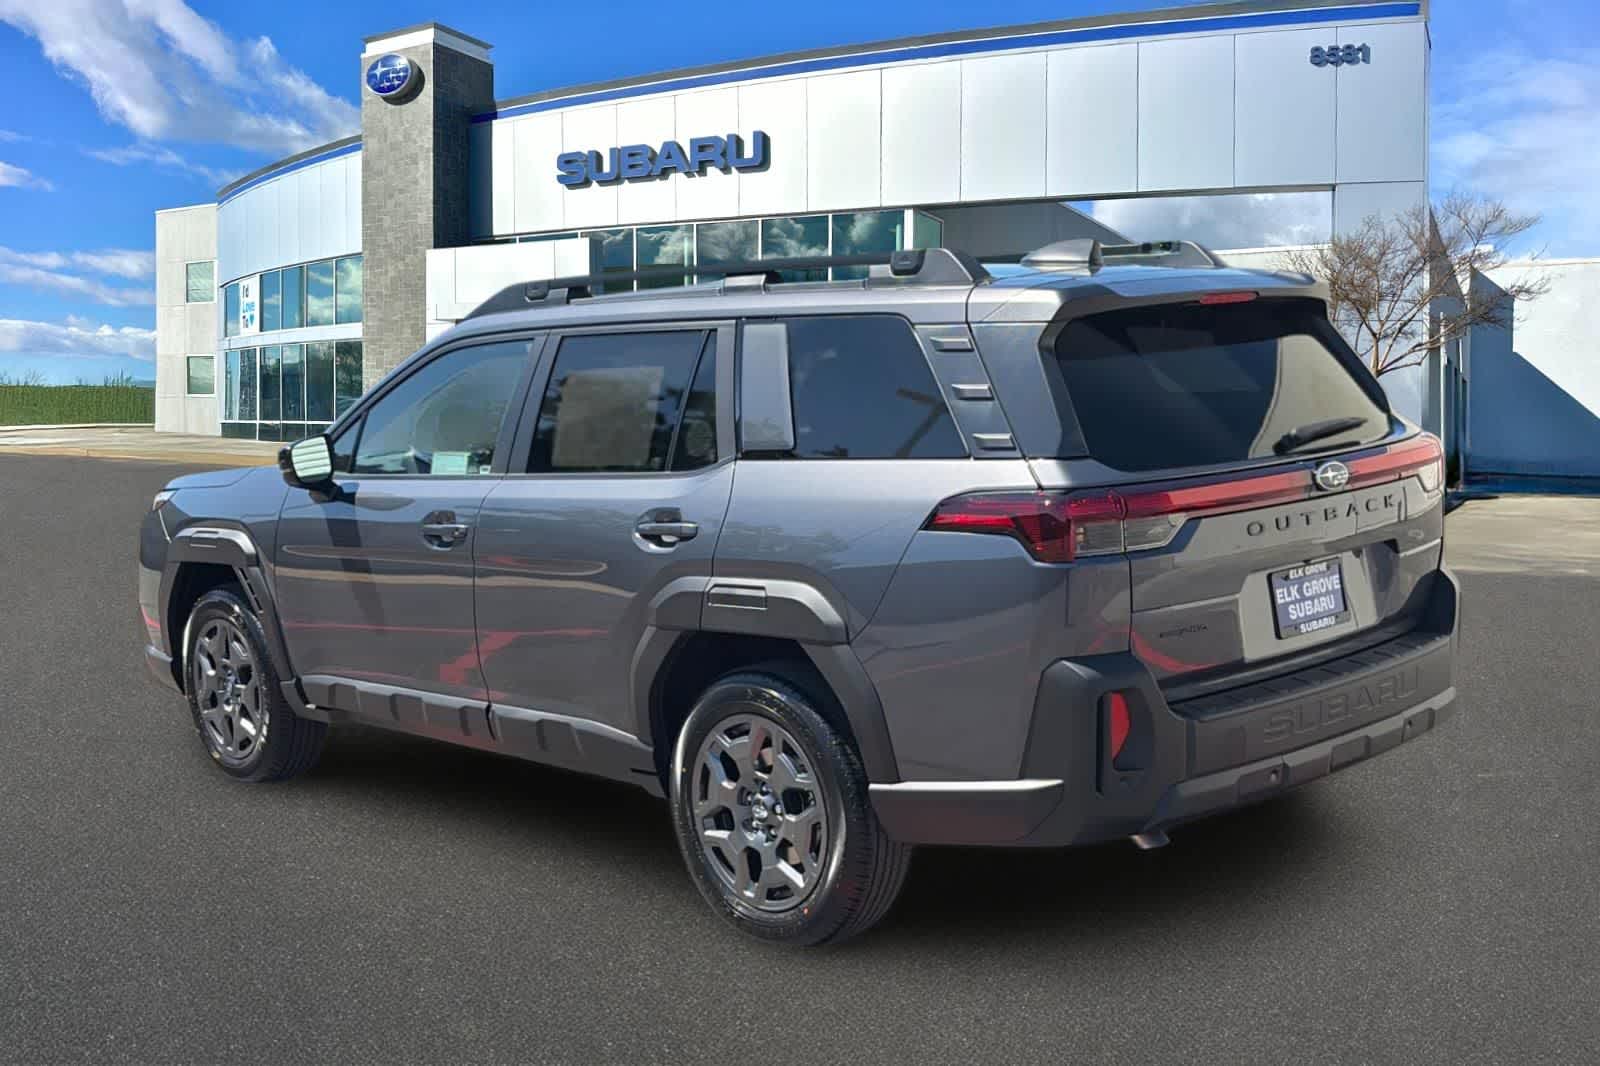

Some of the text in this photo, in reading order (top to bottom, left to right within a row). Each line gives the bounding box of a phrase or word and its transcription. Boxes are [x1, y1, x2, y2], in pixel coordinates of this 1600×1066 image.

[556, 129, 770, 190] SUBARU
[1247, 495, 1393, 536] OUTBACK
[1289, 566, 1304, 579] ELK
[1276, 575, 1341, 604] ELK GROVE
[1288, 594, 1335, 620] SUBARU
[1300, 615, 1336, 633] SUBARU
[1264, 667, 1420, 741] SUBARU
